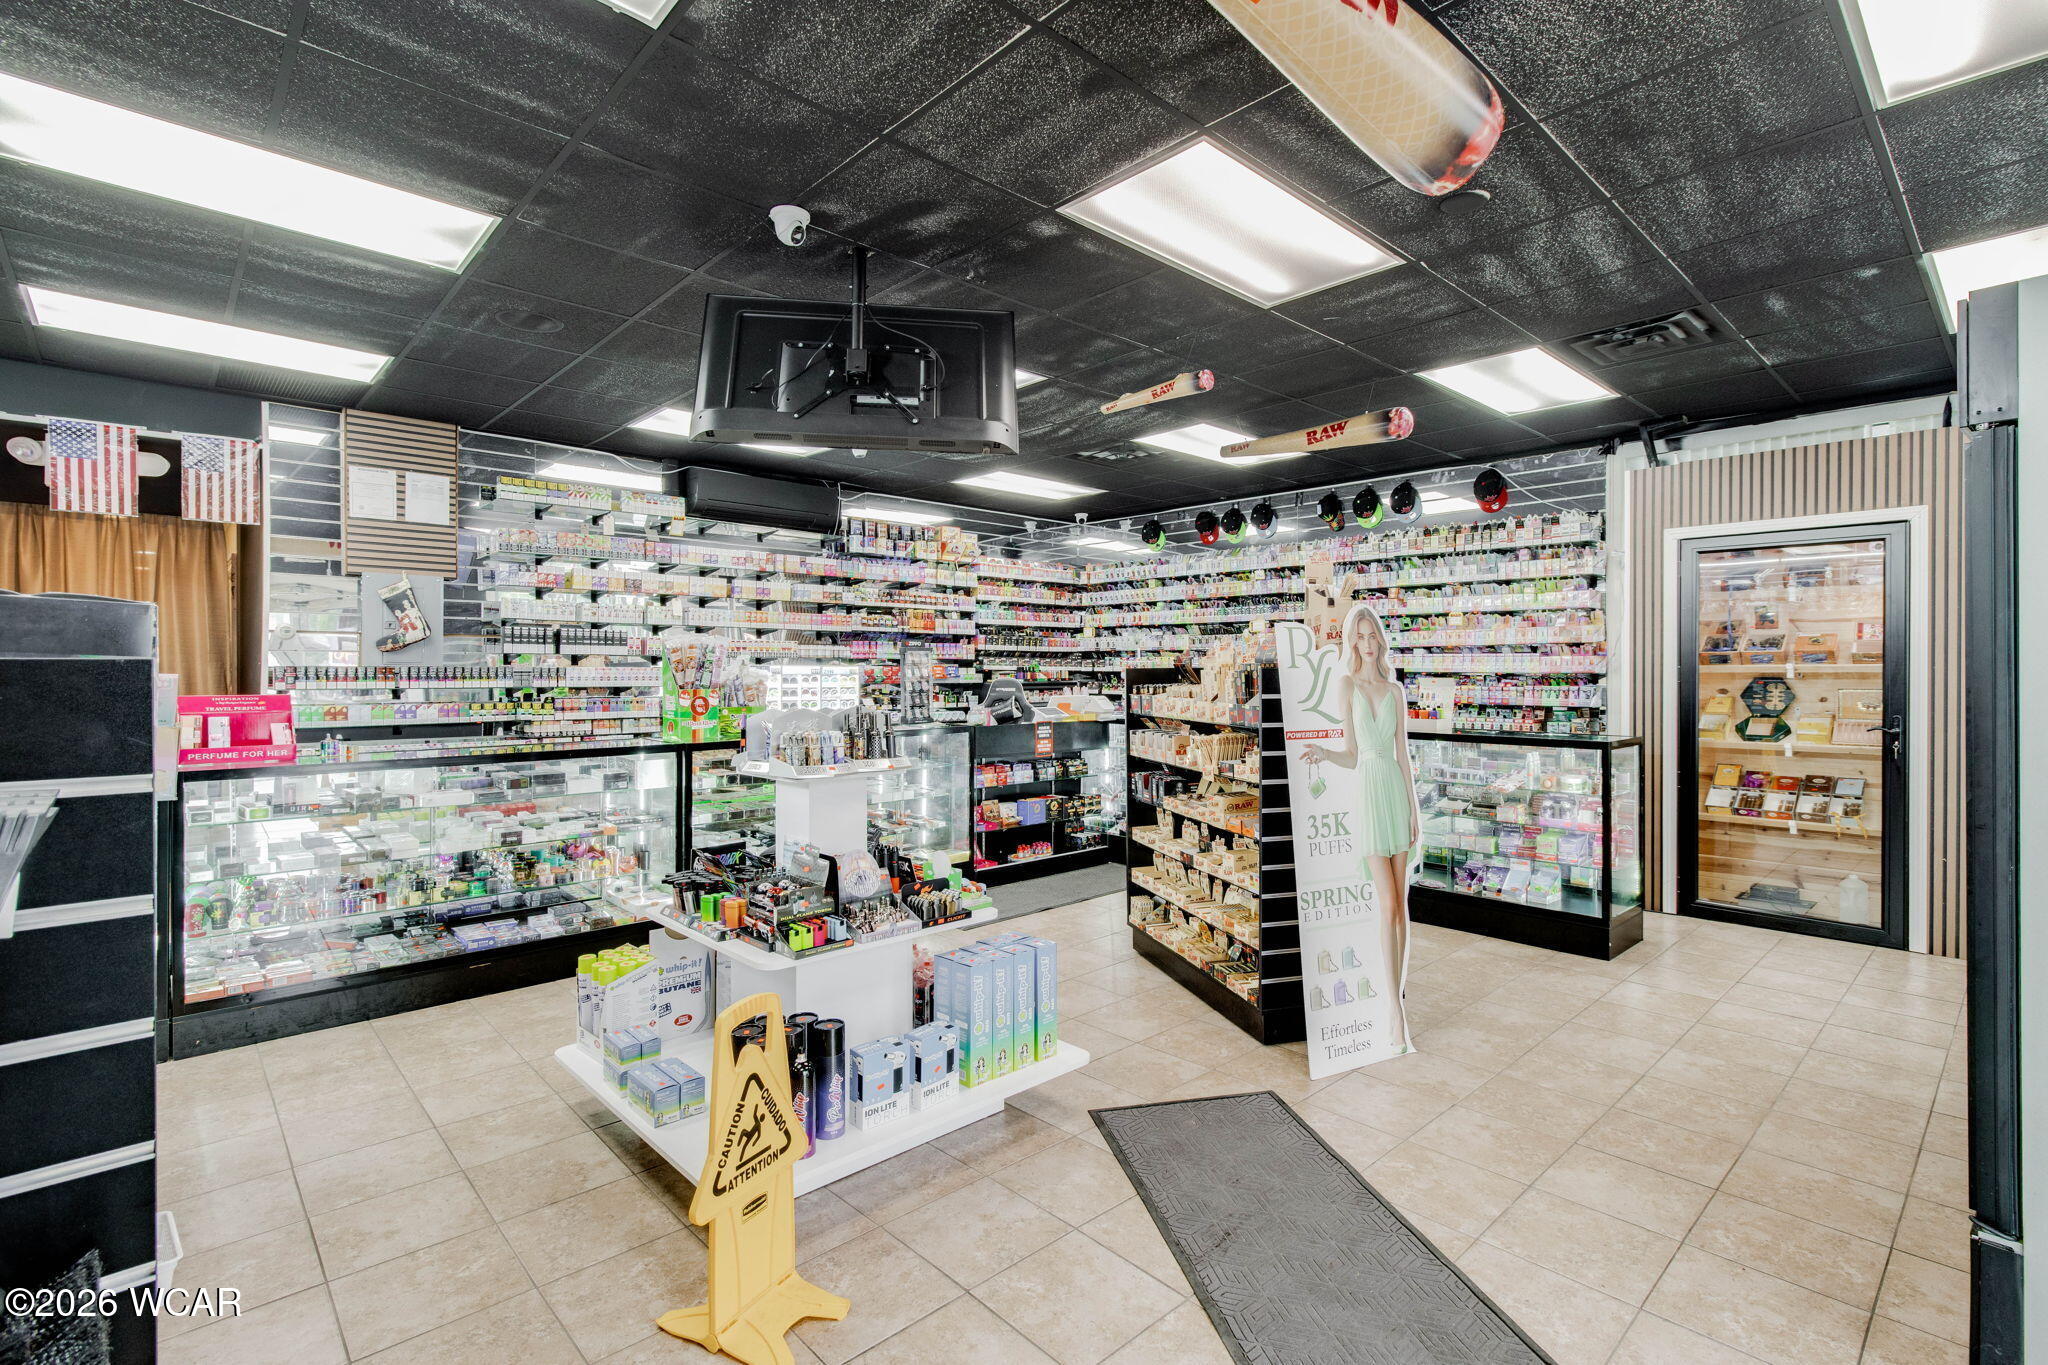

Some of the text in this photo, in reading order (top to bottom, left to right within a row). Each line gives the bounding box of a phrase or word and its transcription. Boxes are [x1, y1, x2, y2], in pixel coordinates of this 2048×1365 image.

[1150, 381, 1176, 399] RAW
[1305, 420, 1350, 446] RAW
[1230, 443, 1251, 454] RAW
[1326, 631, 1343, 640] RA
[1286, 731, 1318, 739] POWERED
[187, 749, 288, 761] PERFUME FOR HER
[1235, 800, 1254, 810] RAW
[1307, 811, 1352, 841] 35K
[1309, 838, 1353, 858] PUFFS
[1300, 882, 1374, 911] SPRING
[1303, 902, 1374, 924] EDITION
[665, 958, 703, 973] whip-it!
[1319, 1017, 1374, 1042] Effortless
[1323, 1037, 1372, 1061] Timeless
[923, 1080, 950, 1098] ION LITE
[761, 1087, 787, 1132] CUIDADO
[864, 1100, 897, 1118] ION LITE
[717, 1102, 746, 1169] CAUTION
[727, 1148, 779, 1193] ATTENTION
